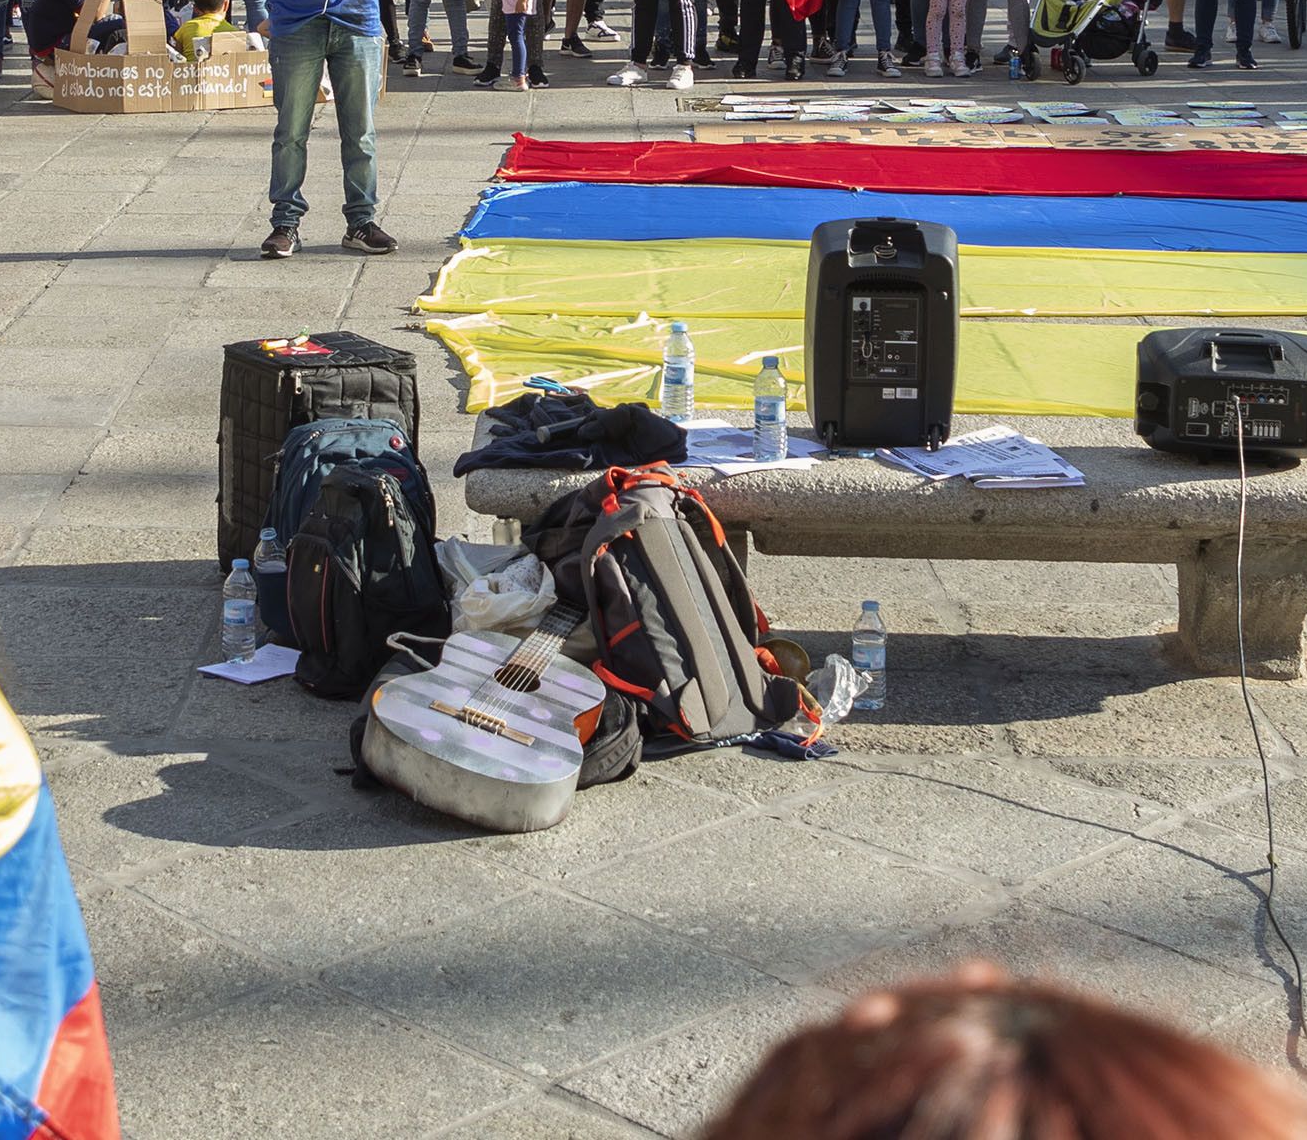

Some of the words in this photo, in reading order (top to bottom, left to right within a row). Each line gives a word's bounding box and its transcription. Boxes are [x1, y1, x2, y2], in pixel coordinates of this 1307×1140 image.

[145, 66, 165, 79] no
[173, 63, 230, 79] estamos
[69, 79, 106, 99] estado
[109, 81, 135, 98] nos
[137, 80, 172, 98] está
[180, 77, 248, 98] matando!
